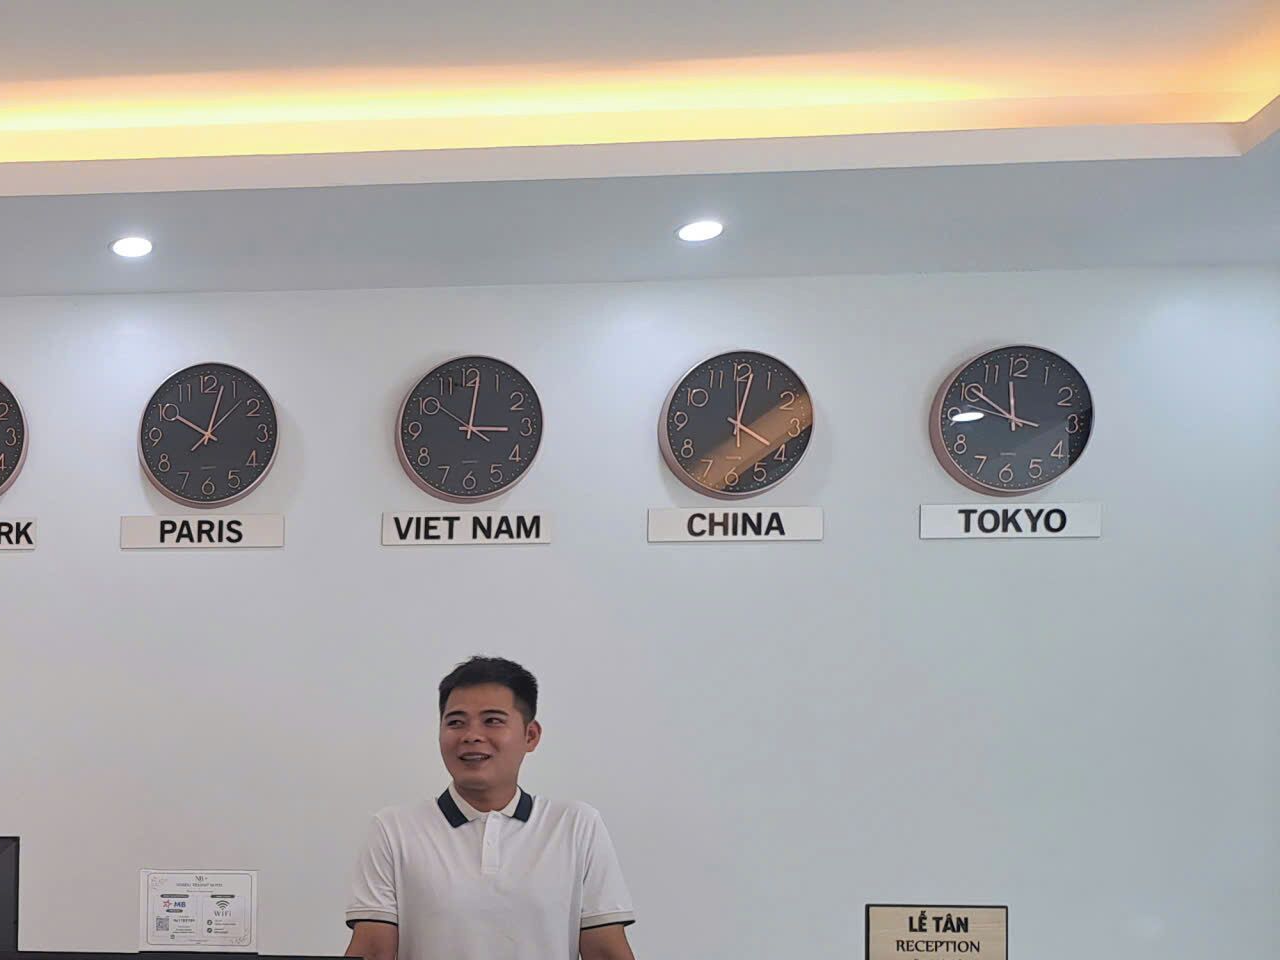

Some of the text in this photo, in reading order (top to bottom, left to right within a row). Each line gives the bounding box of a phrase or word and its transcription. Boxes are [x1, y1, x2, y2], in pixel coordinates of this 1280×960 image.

[733, 363, 752, 381] 12
[985, 365, 999, 384] 11
[1009, 358, 1028, 377] 12
[1045, 367, 1049, 384] 1
[200, 376, 218, 393] 12
[439, 378, 452, 395] 11
[462, 369, 480, 387] 12
[495, 375, 499, 392] 1
[710, 370, 724, 388] 11
[767, 372, 771, 390] 1
[178, 384, 191, 402] 11
[232, 381, 236, 398] 1
[688, 388, 708, 407] 10
[961, 383, 983, 402] 10
[1058, 387, 1072, 406] 2
[246, 399, 260, 416] 2
[420, 397, 440, 415] 10
[510, 392, 524, 410] 2
[780, 392, 794, 410] 2
[159, 404, 179, 421] 10
[674, 412, 688, 431] 9
[409, 422, 422, 440] 9
[520, 418, 532, 436] 3
[788, 418, 800, 437] 3
[1065, 414, 1078, 433] 3
[5, 428, 16, 445] 3
[149, 428, 162, 446] 9
[256, 424, 268, 442] 3
[509, 445, 521, 462] 4
[681, 439, 693, 458] 8
[774, 444, 786, 462] 4
[954, 435, 966, 454] 8
[1051, 441, 1063, 459] 4
[158, 454, 170, 472] 8
[246, 451, 257, 467] 4
[418, 448, 430, 466] 8
[975, 456, 986, 473] 7
[438, 466, 450, 484] 7
[490, 464, 502, 482] 5
[702, 460, 713, 476] 7
[725, 468, 738, 486] 6
[753, 463, 766, 481] 5
[999, 464, 1013, 482] 6
[1029, 459, 1042, 478] 5
[178, 472, 190, 489] 7
[202, 477, 215, 495] 6
[228, 470, 240, 488] 5
[463, 471, 476, 489] 6
[394, 516, 540, 539] VIET NAM
[687, 513, 785, 536] CHINA
[958, 509, 1066, 533] TOKYO
[160, 520, 243, 543] PARIS
[909, 911, 968, 932] LỄ TÂN
[896, 940, 980, 952] RECEPTION
